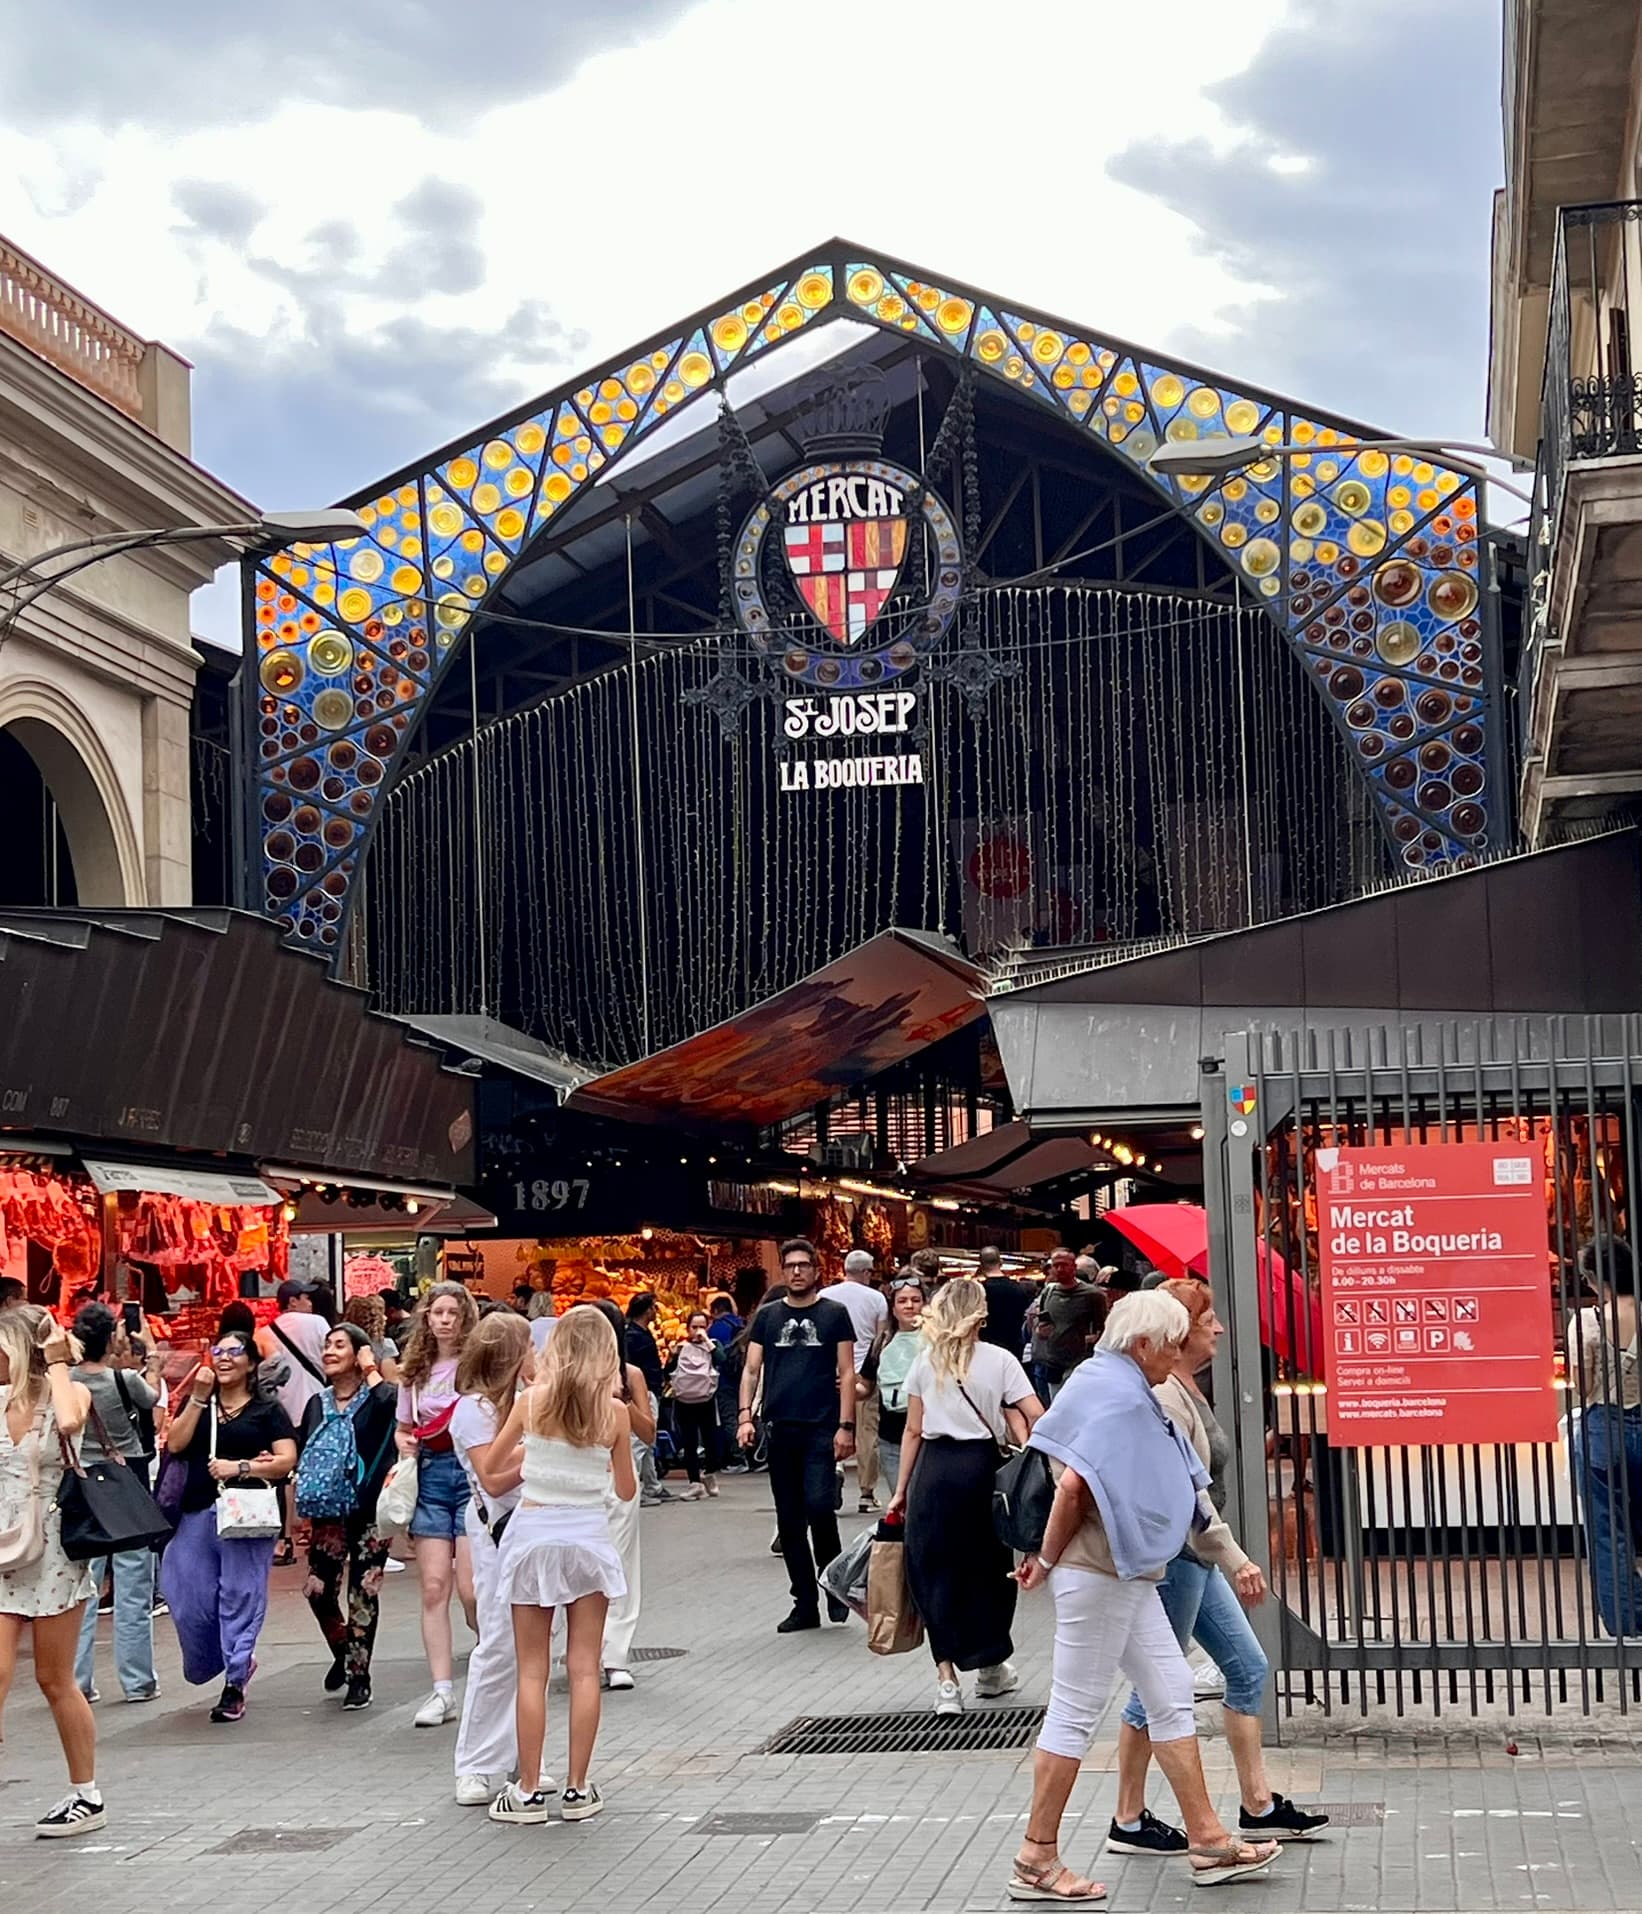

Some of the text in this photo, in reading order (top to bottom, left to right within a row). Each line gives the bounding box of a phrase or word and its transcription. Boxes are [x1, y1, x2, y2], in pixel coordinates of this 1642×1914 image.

[788, 476, 904, 523] MERCAT
[815, 692, 917, 737] JOSEP
[780, 754, 923, 791] LA BOQUERIA
[1359, 1163, 1406, 1176] Mercats
[512, 1179, 591, 1211] 1897
[1360, 1177, 1436, 1190] de Barcelona
[1330, 1205, 1415, 1229] Mercat
[1331, 1227, 1502, 1257] de la Boqueria
[1331, 1266, 1344, 1276] De
[1378, 1267, 1385, 1275] a
[1336, 1365, 1371, 1376] Compra
[1337, 1376, 1365, 1387] Servei
[1366, 1378, 1373, 1386] a
